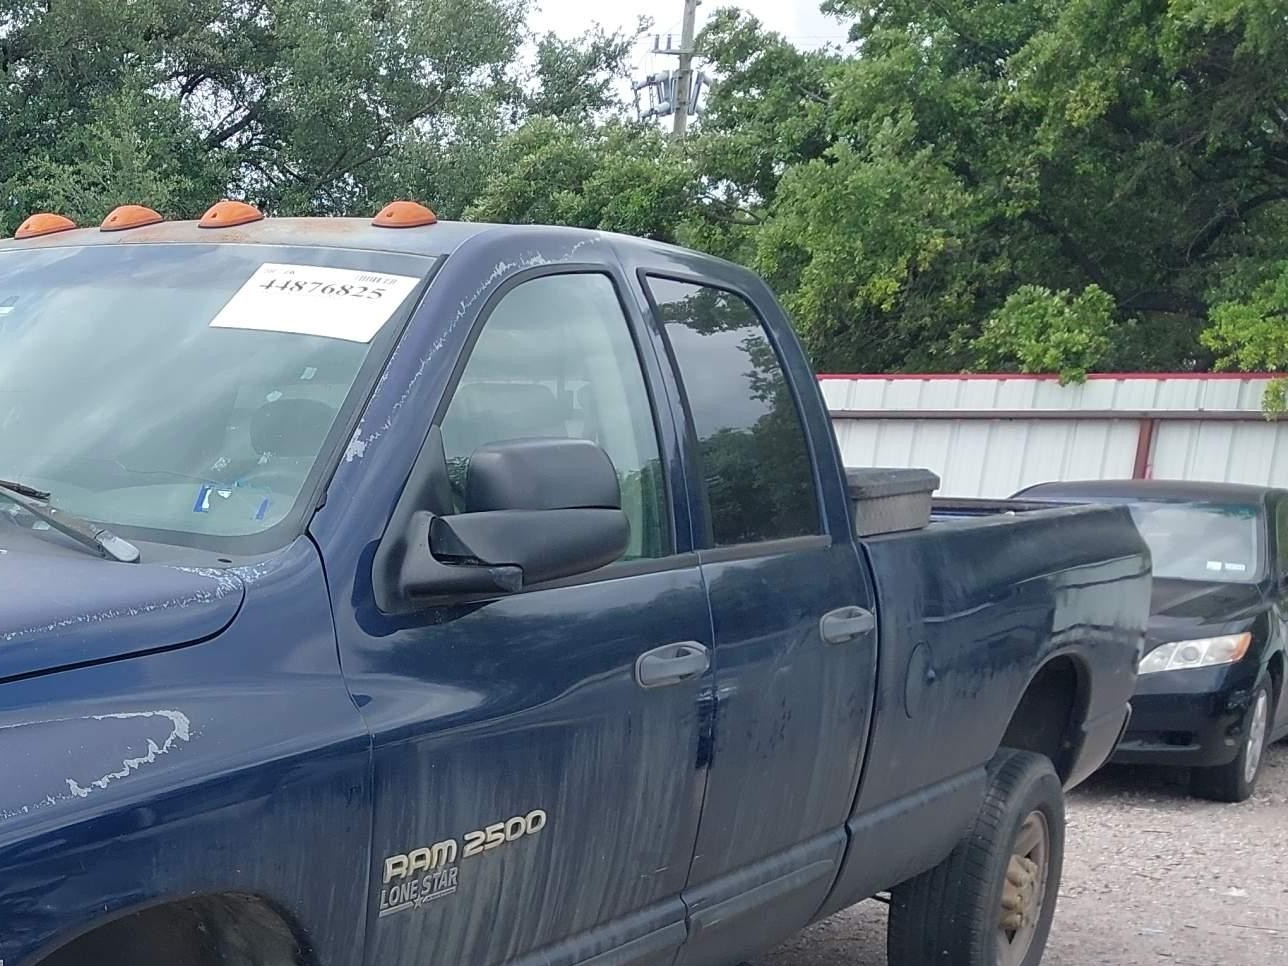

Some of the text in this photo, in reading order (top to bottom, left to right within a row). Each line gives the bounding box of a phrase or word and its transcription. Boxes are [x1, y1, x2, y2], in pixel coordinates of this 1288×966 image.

[259, 278, 387, 300] 44876825
[383, 809, 547, 884] RAM 2500
[380, 867, 458, 910] LONE STAR
